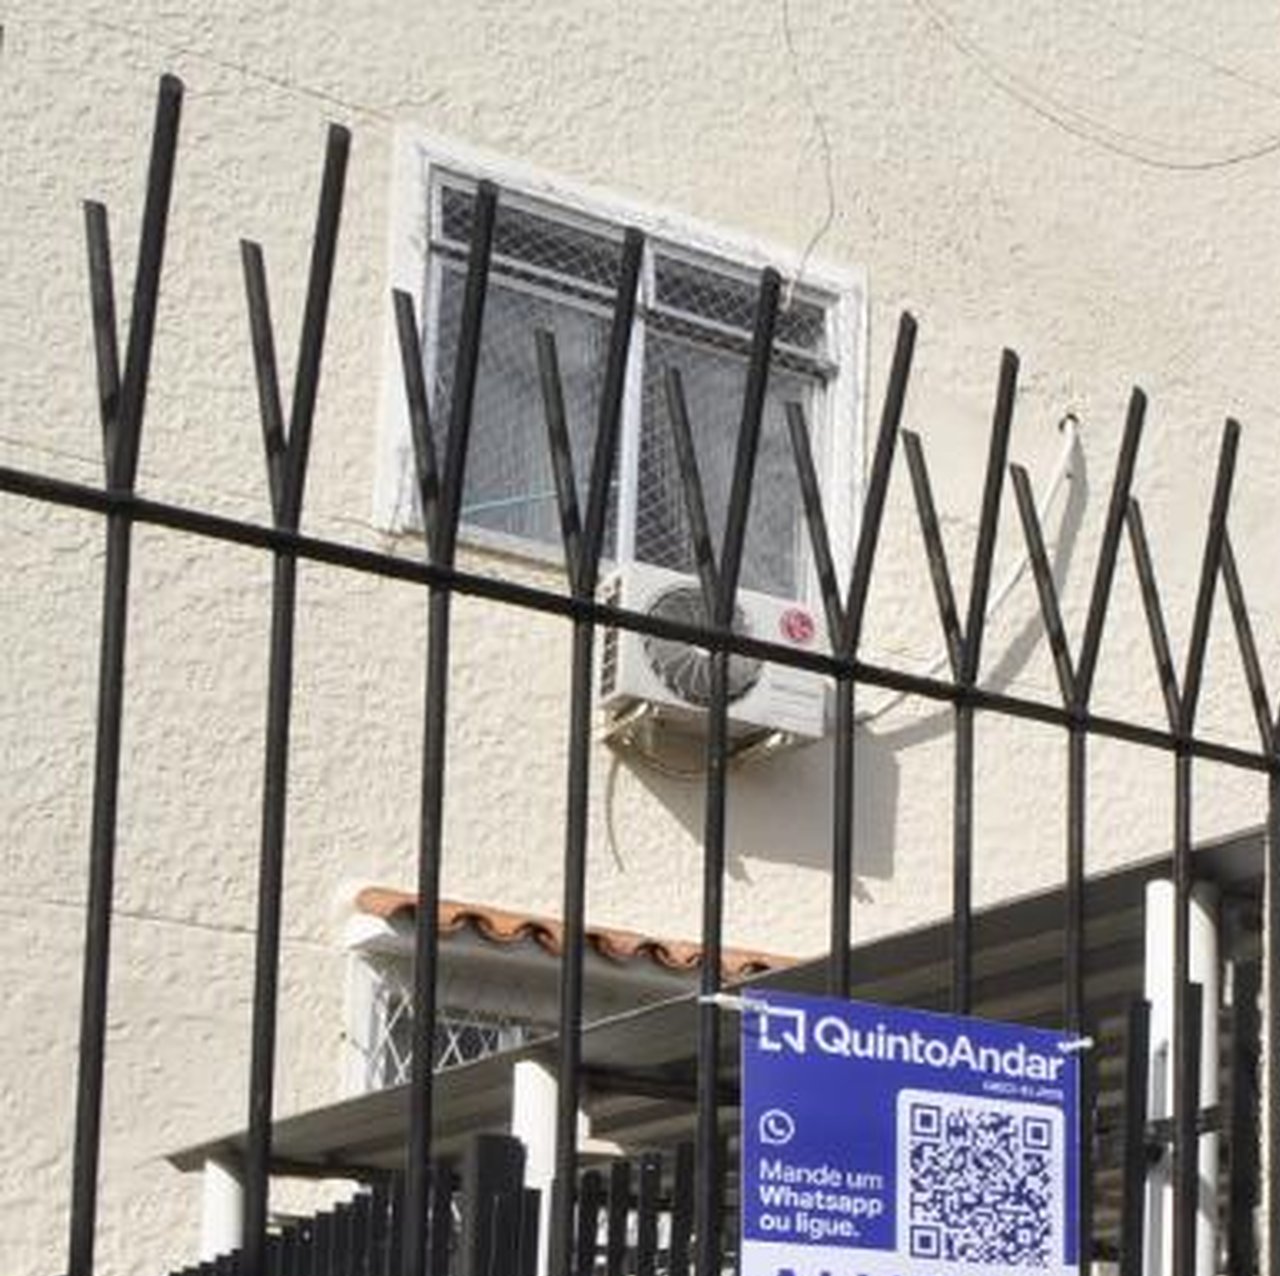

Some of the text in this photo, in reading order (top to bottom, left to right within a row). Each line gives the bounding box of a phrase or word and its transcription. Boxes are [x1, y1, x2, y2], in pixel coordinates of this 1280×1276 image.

[814, 1016, 1065, 1081] QuintoAndar
[759, 1158, 884, 1190] Mande um
[759, 1184, 883, 1218] Whatsapp
[759, 1211, 861, 1240] ou ligue.
